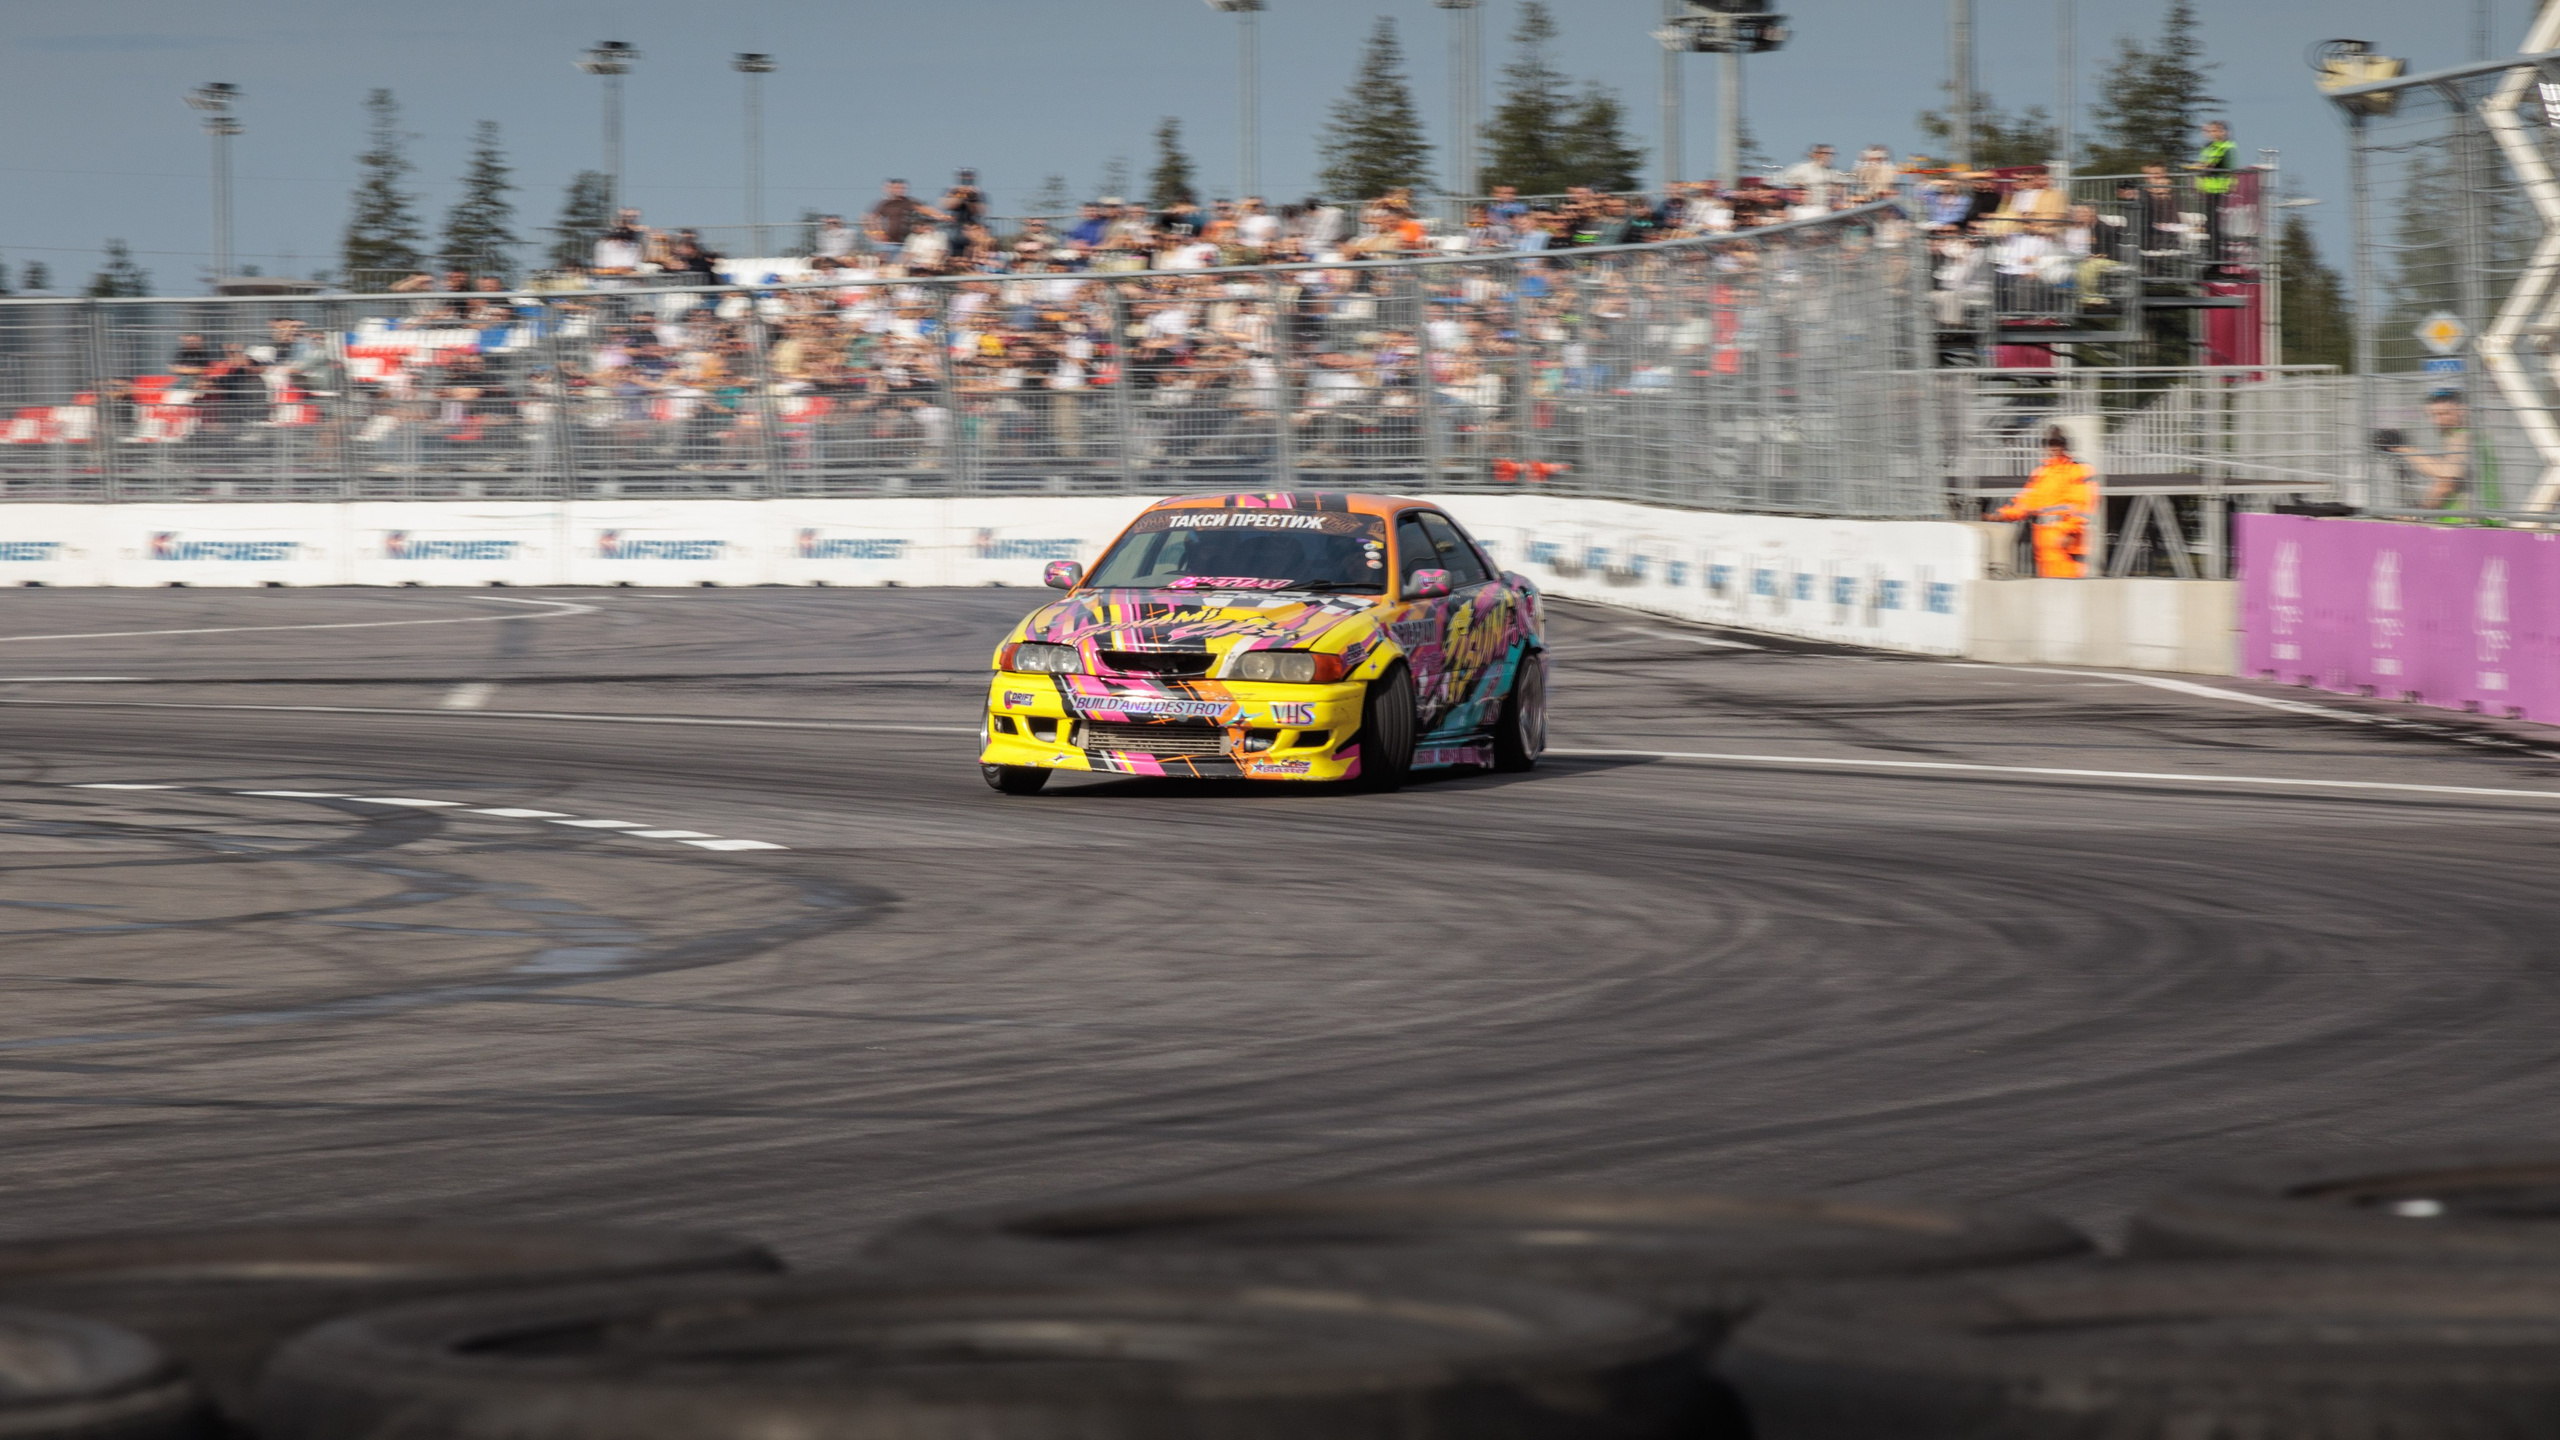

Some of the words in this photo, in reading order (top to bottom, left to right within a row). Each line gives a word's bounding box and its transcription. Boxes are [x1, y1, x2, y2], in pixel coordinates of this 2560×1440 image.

[1169, 514, 1232, 528] ТАКСИ
[1228, 513, 1327, 530] ПРЕСТИЖ
[1011, 692, 1035, 701] DRIFT
[1075, 697, 1120, 710] BUILD
[1119, 700, 1152, 711] AND
[1153, 701, 1228, 716] DESTROY
[1271, 703, 1314, 725] VHS
